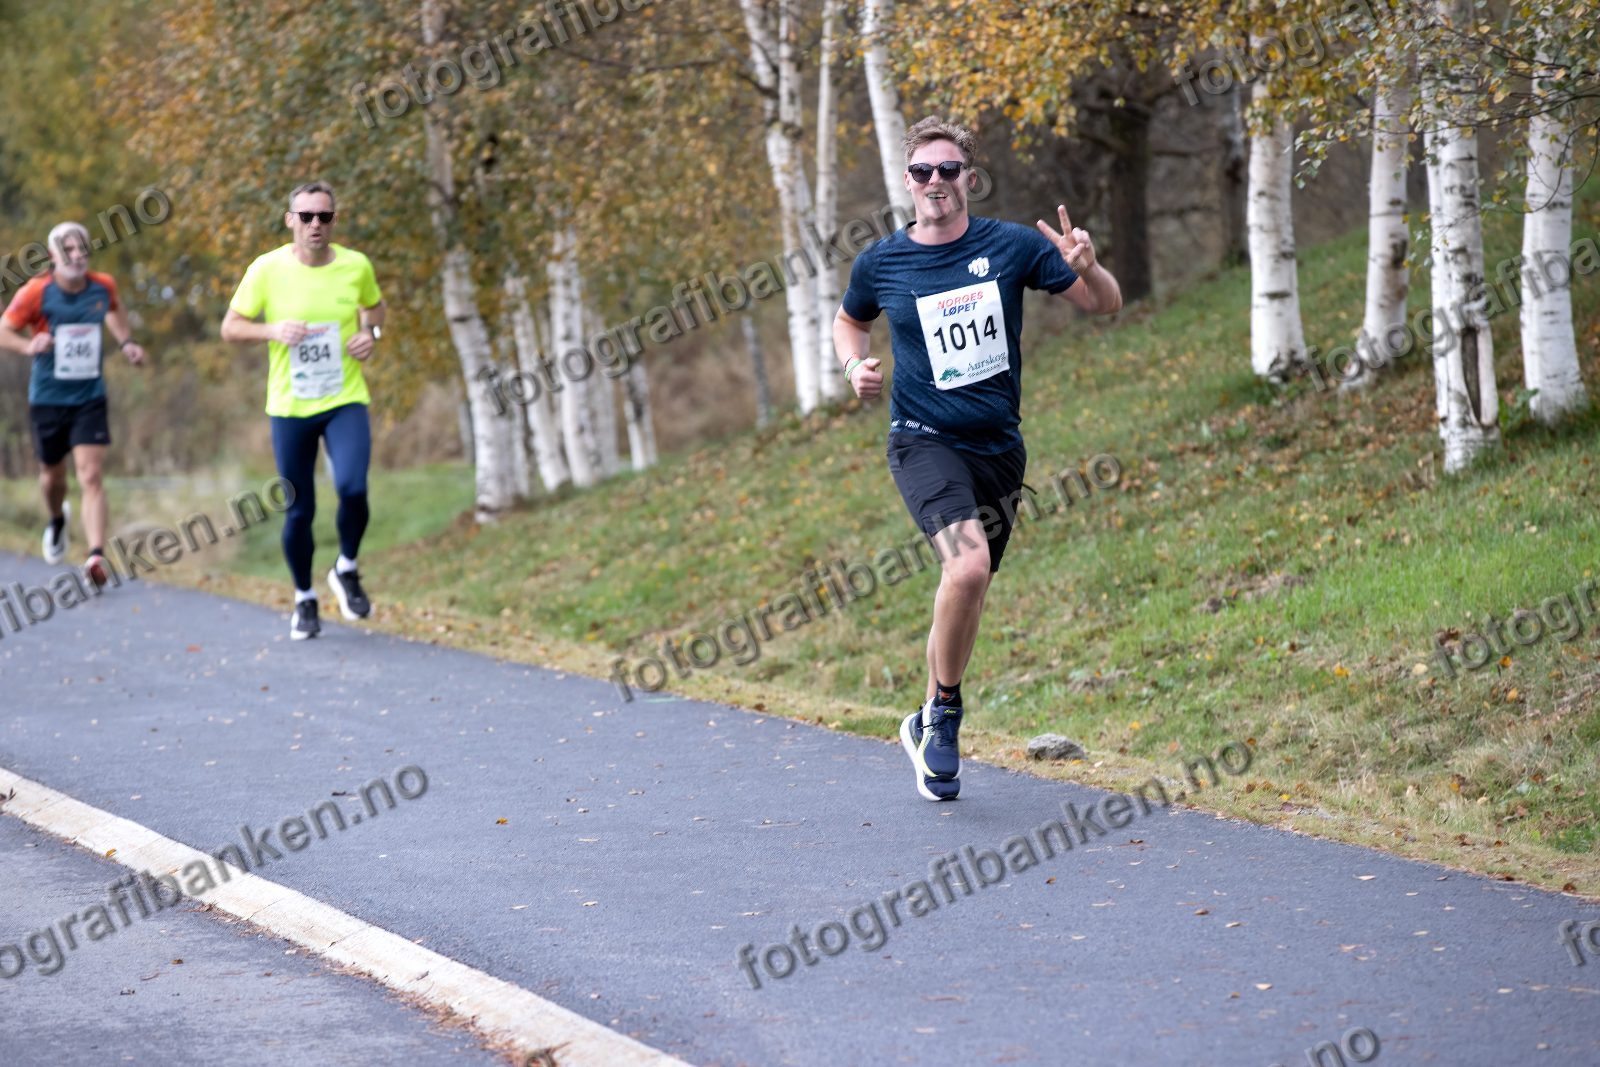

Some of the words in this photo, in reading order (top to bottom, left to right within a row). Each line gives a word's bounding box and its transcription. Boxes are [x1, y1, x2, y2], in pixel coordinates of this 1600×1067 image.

[937, 291, 984, 310] NORGES
[943, 302, 977, 317] LØPET
[933, 314, 998, 354] 1014
[65, 342, 92, 358] 246
[299, 343, 330, 362] 834
[966, 352, 1008, 372] Aurskog
